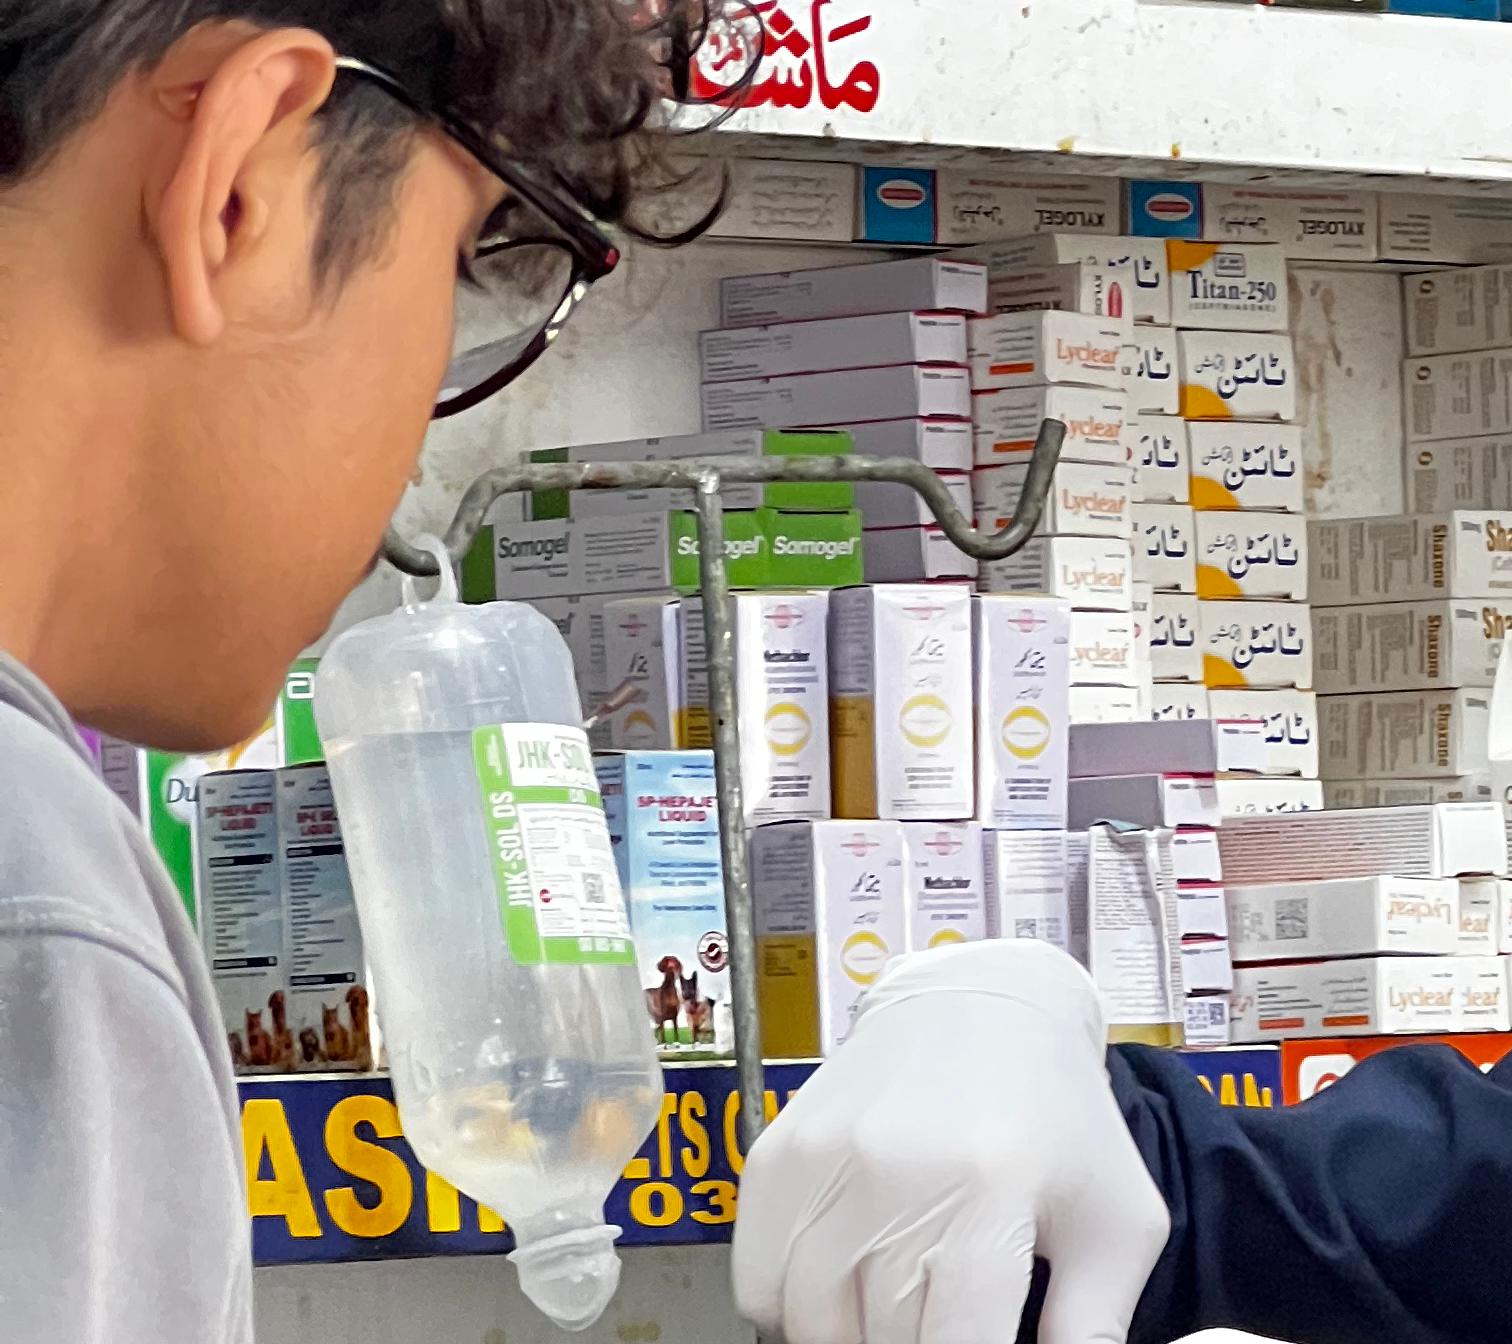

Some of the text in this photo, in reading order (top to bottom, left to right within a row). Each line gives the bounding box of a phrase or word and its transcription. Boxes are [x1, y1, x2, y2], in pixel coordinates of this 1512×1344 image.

[1186, 270, 1277, 301] Titan-250
[1056, 338, 1119, 365] Lyclear
[1066, 414, 1122, 440] yclear
[1062, 488, 1126, 515] Lyclear
[1062, 561, 1126, 590] Lyclear
[1074, 640, 1129, 668] yclear
[497, 824, 532, 907] JHK-SOL
